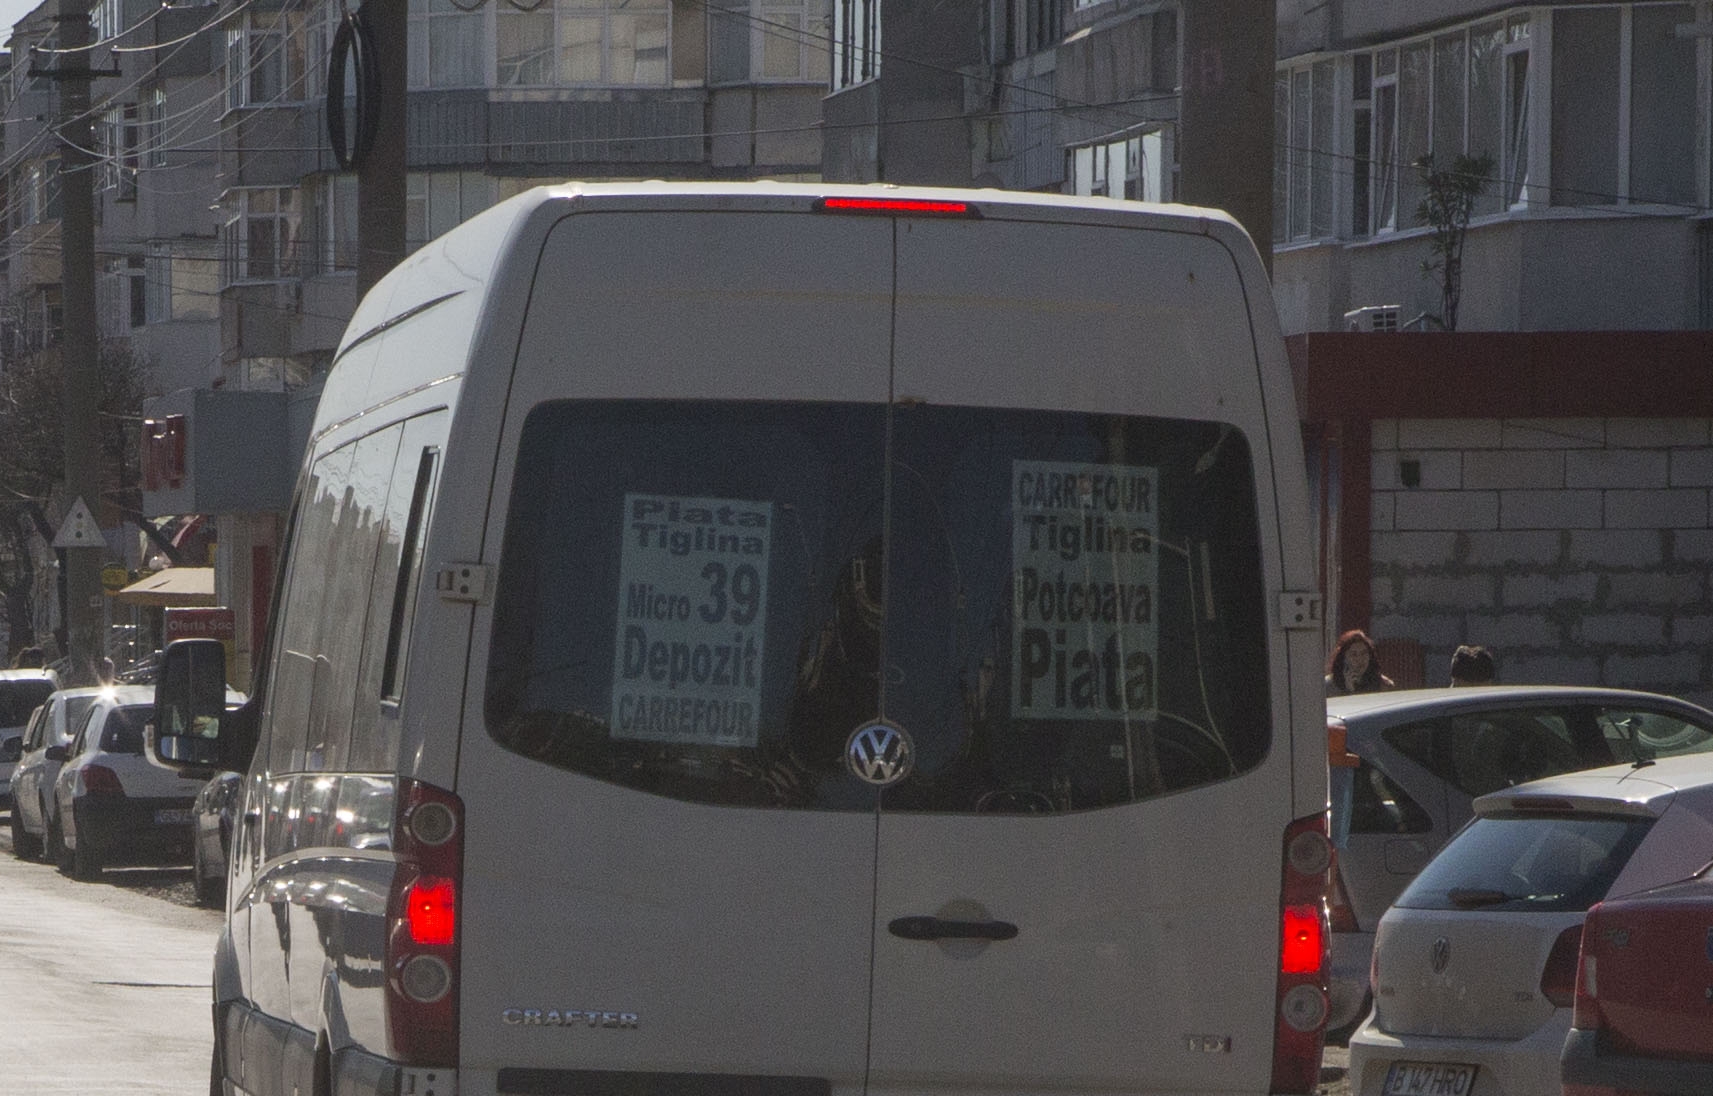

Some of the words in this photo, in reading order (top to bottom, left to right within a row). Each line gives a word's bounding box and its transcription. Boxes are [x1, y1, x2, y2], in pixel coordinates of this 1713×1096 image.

[633, 501, 767, 528] Piata
[1019, 472, 1150, 513] CARREFOUR
[632, 523, 764, 556] Tiglina
[1022, 515, 1151, 562] Tiglina
[628, 583, 690, 621] Micro
[697, 561, 761, 626] 39
[1022, 568, 1151, 625] Potcoava
[623, 624, 757, 690] Depozit
[1020, 628, 1154, 711] Piata
[619, 693, 755, 737] CARREFOUR
[502, 1008, 638, 1029] CRAFTER
